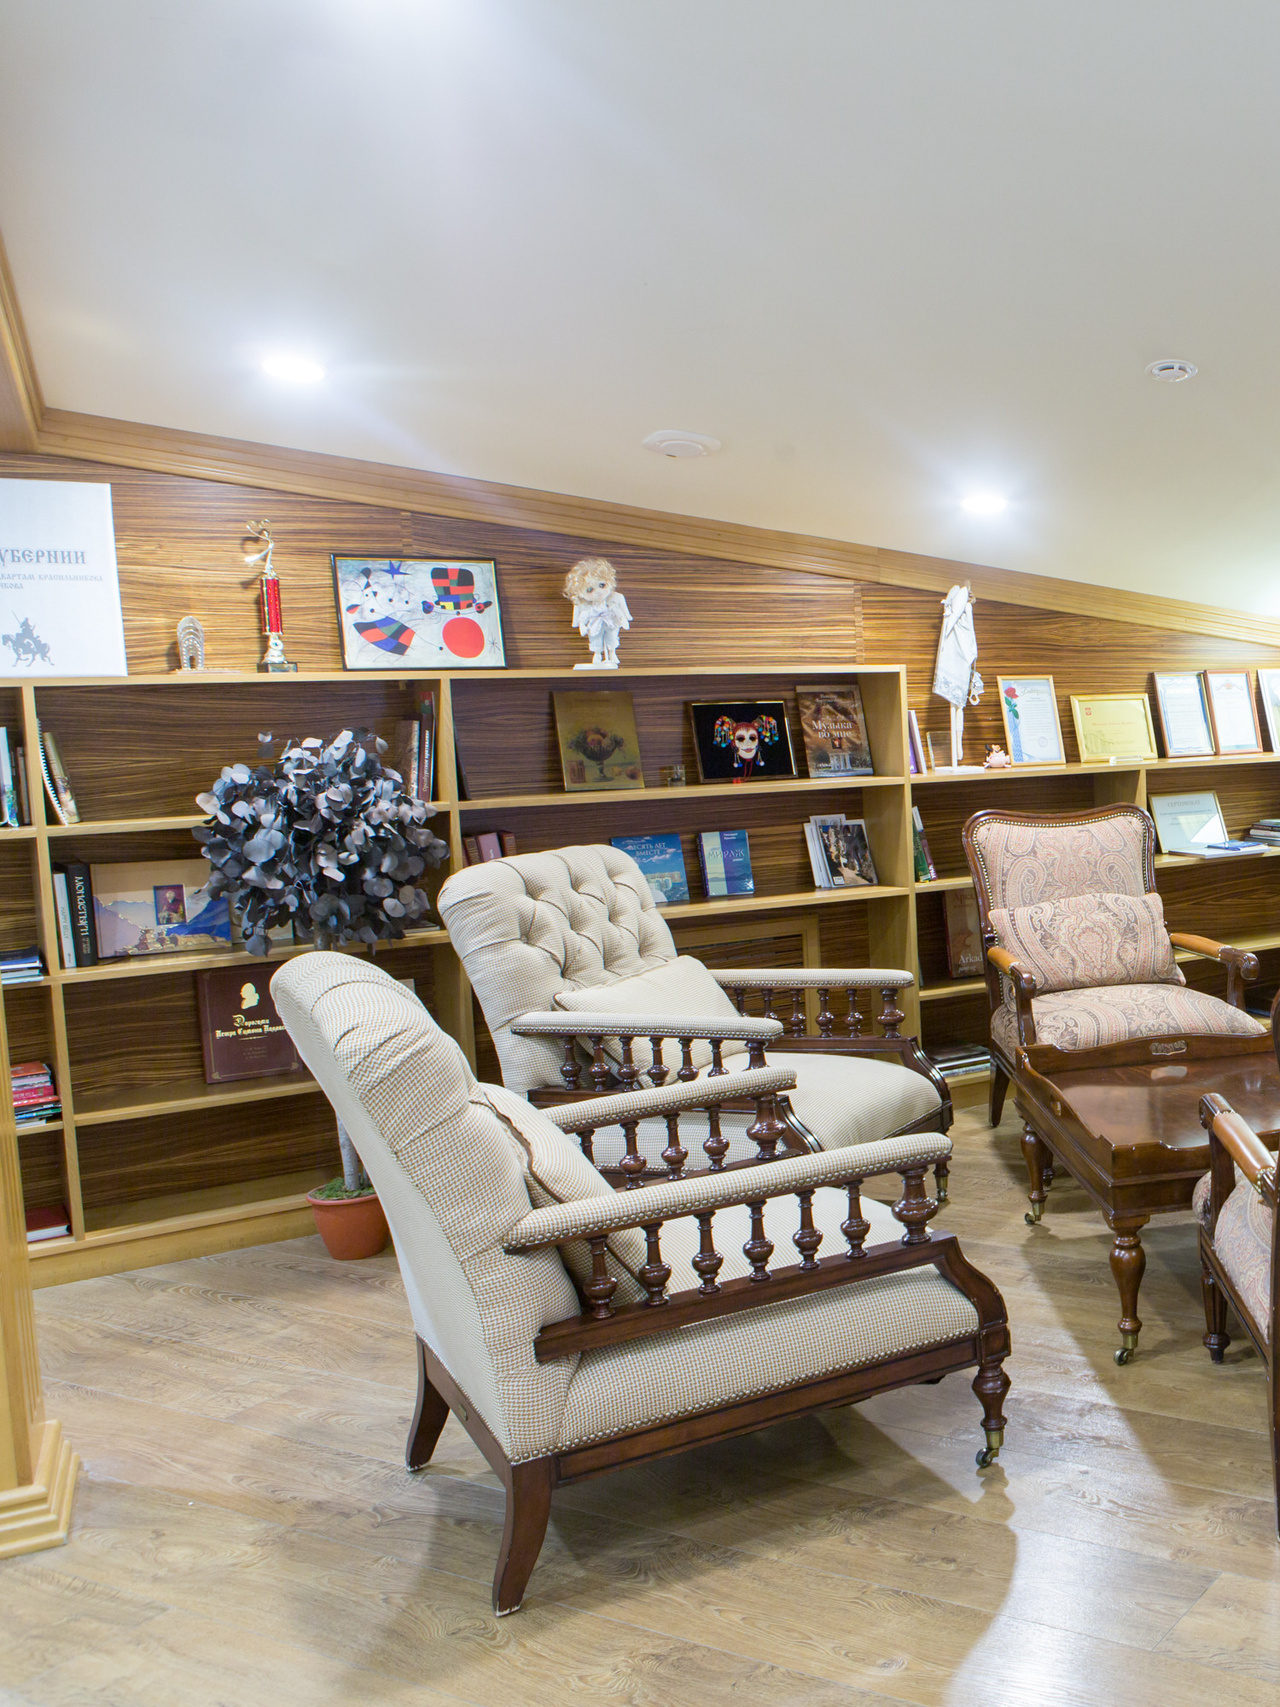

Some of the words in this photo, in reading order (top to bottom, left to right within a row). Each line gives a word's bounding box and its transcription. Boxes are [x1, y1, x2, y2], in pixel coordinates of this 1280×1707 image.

[812, 720, 852, 730] Музыка
[818, 731, 830, 739] во
[833, 730, 852, 738] мне
[708, 849, 745, 859] МИРАЖ
[958, 952, 983, 964] Arkad
[215, 1029, 236, 1039] Петра
[237, 1028, 262, 1036] Симона
[263, 1024, 286, 1033] Паллас
